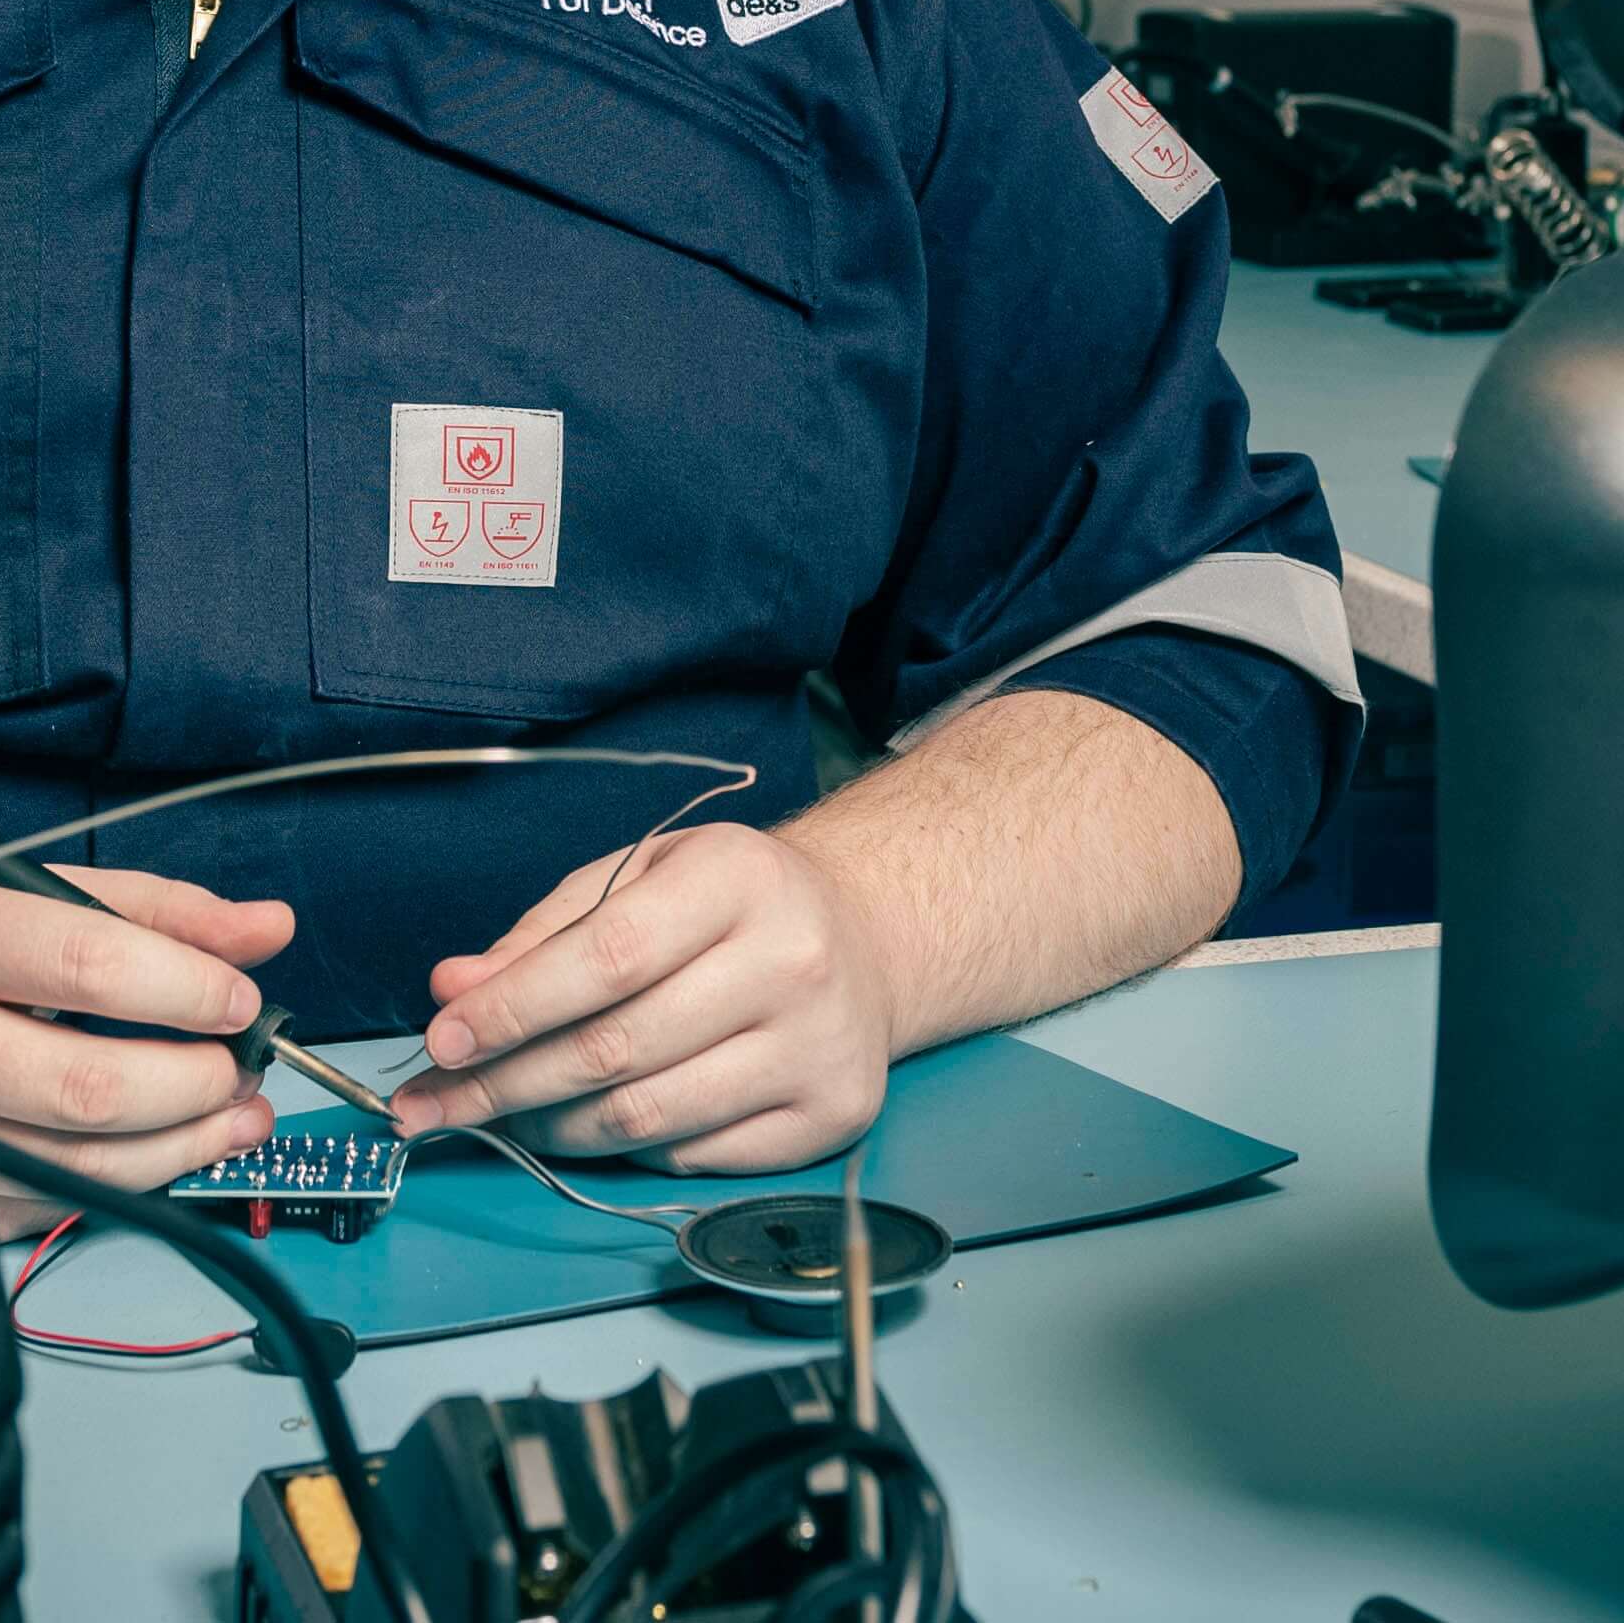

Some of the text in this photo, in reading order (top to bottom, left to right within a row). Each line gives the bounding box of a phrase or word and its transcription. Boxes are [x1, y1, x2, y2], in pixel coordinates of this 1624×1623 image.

[448, 487, 460, 495] EN
[463, 487, 479, 495] ISO
[419, 561, 432, 569] EN
[482, 562, 496, 570] EN
[497, 562, 513, 570] ISO
